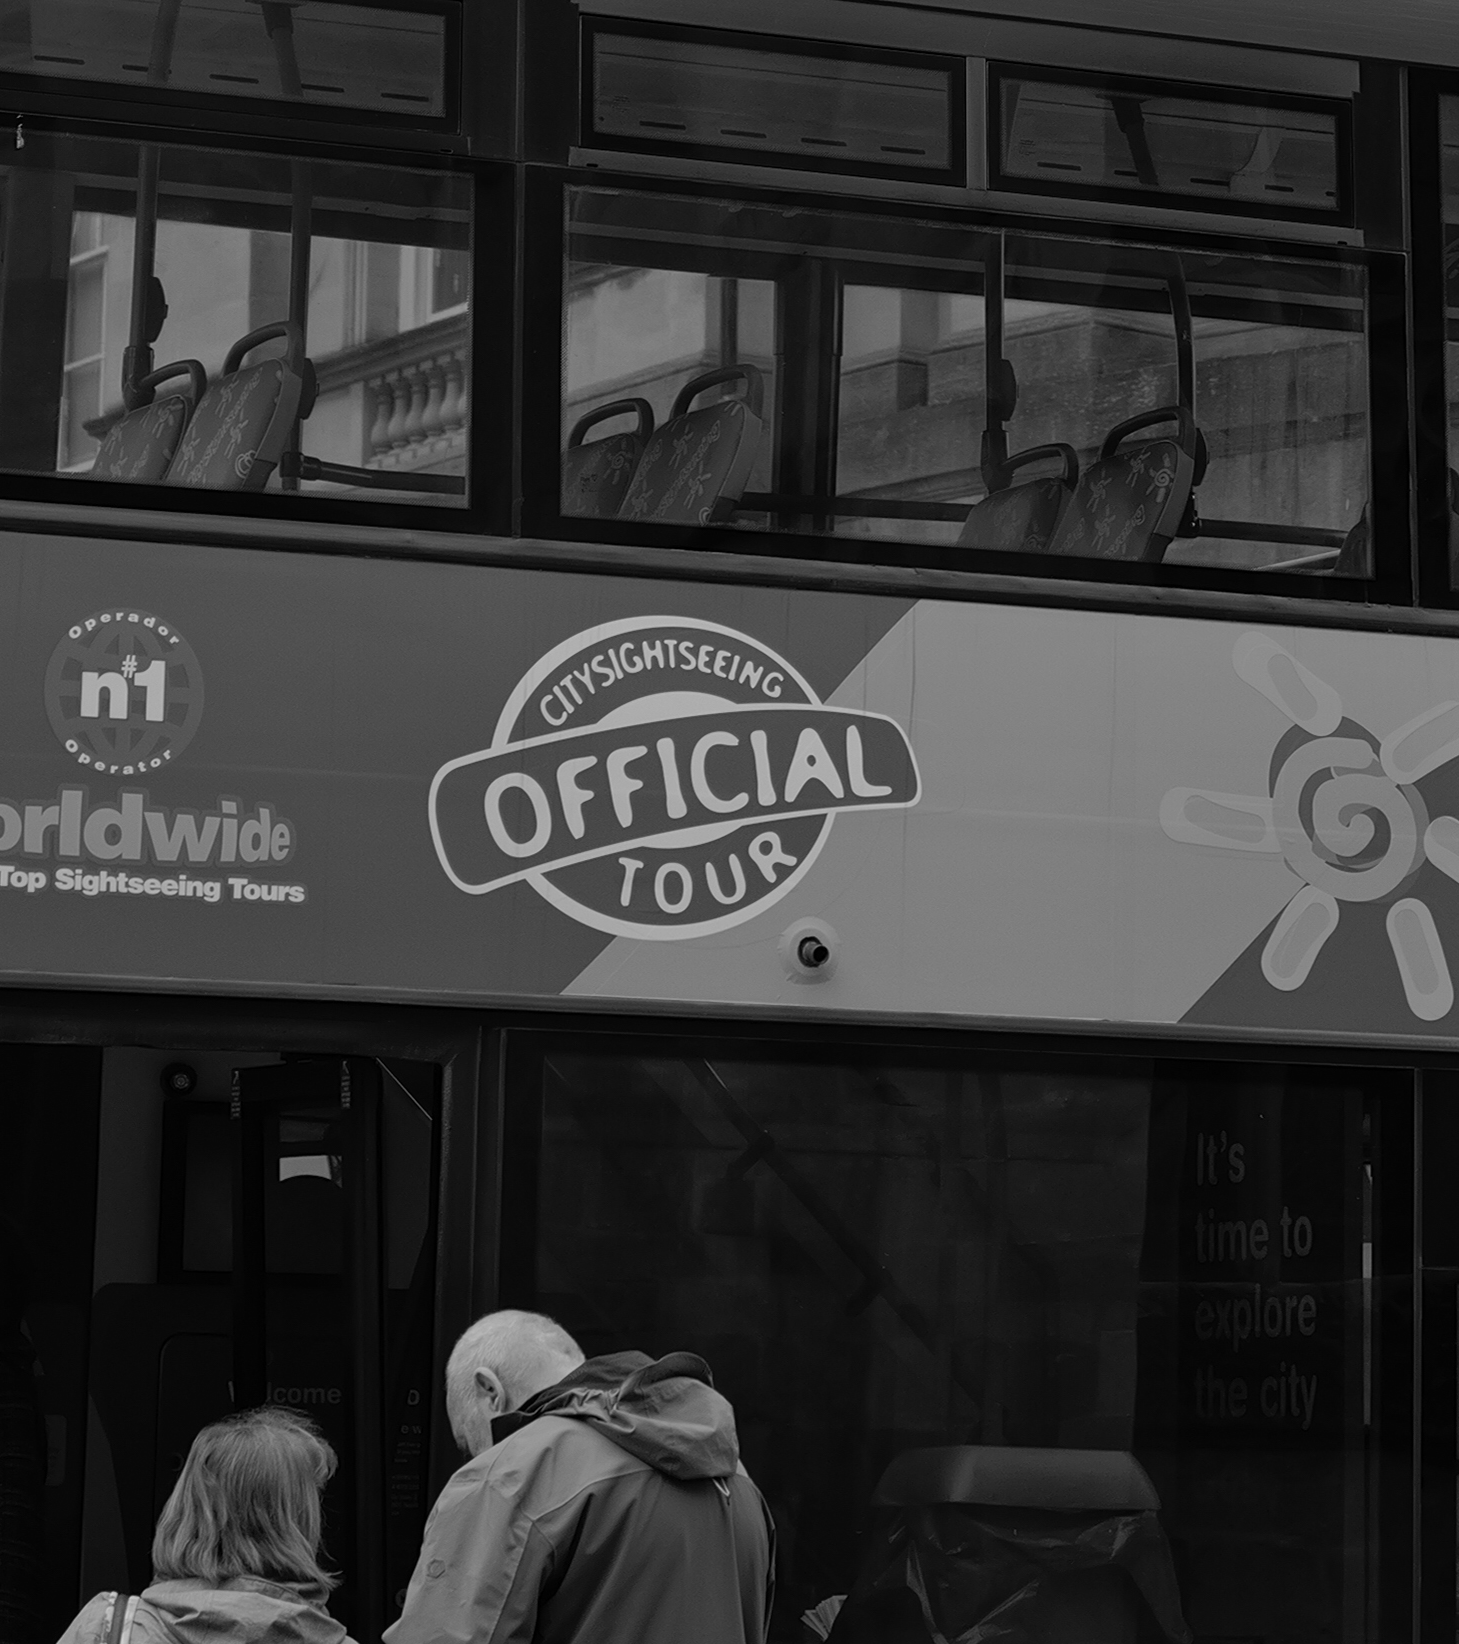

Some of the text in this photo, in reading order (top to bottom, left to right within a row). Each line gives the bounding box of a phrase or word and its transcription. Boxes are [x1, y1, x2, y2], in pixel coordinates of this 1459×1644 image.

[68, 611, 180, 647] Operador
[539, 638, 786, 727] CITYSIGHTSEEING
[65, 739, 173, 776] Operator
[483, 725, 894, 859] OFFICIAL
[54, 868, 221, 903] Sightseeing
[228, 877, 306, 903] Tours
[618, 830, 799, 915] TOUR
[1197, 1130, 1246, 1187] It's
[1195, 1206, 1314, 1264] time to
[1194, 1282, 1317, 1354] explore
[1194, 1360, 1317, 1431] the city
